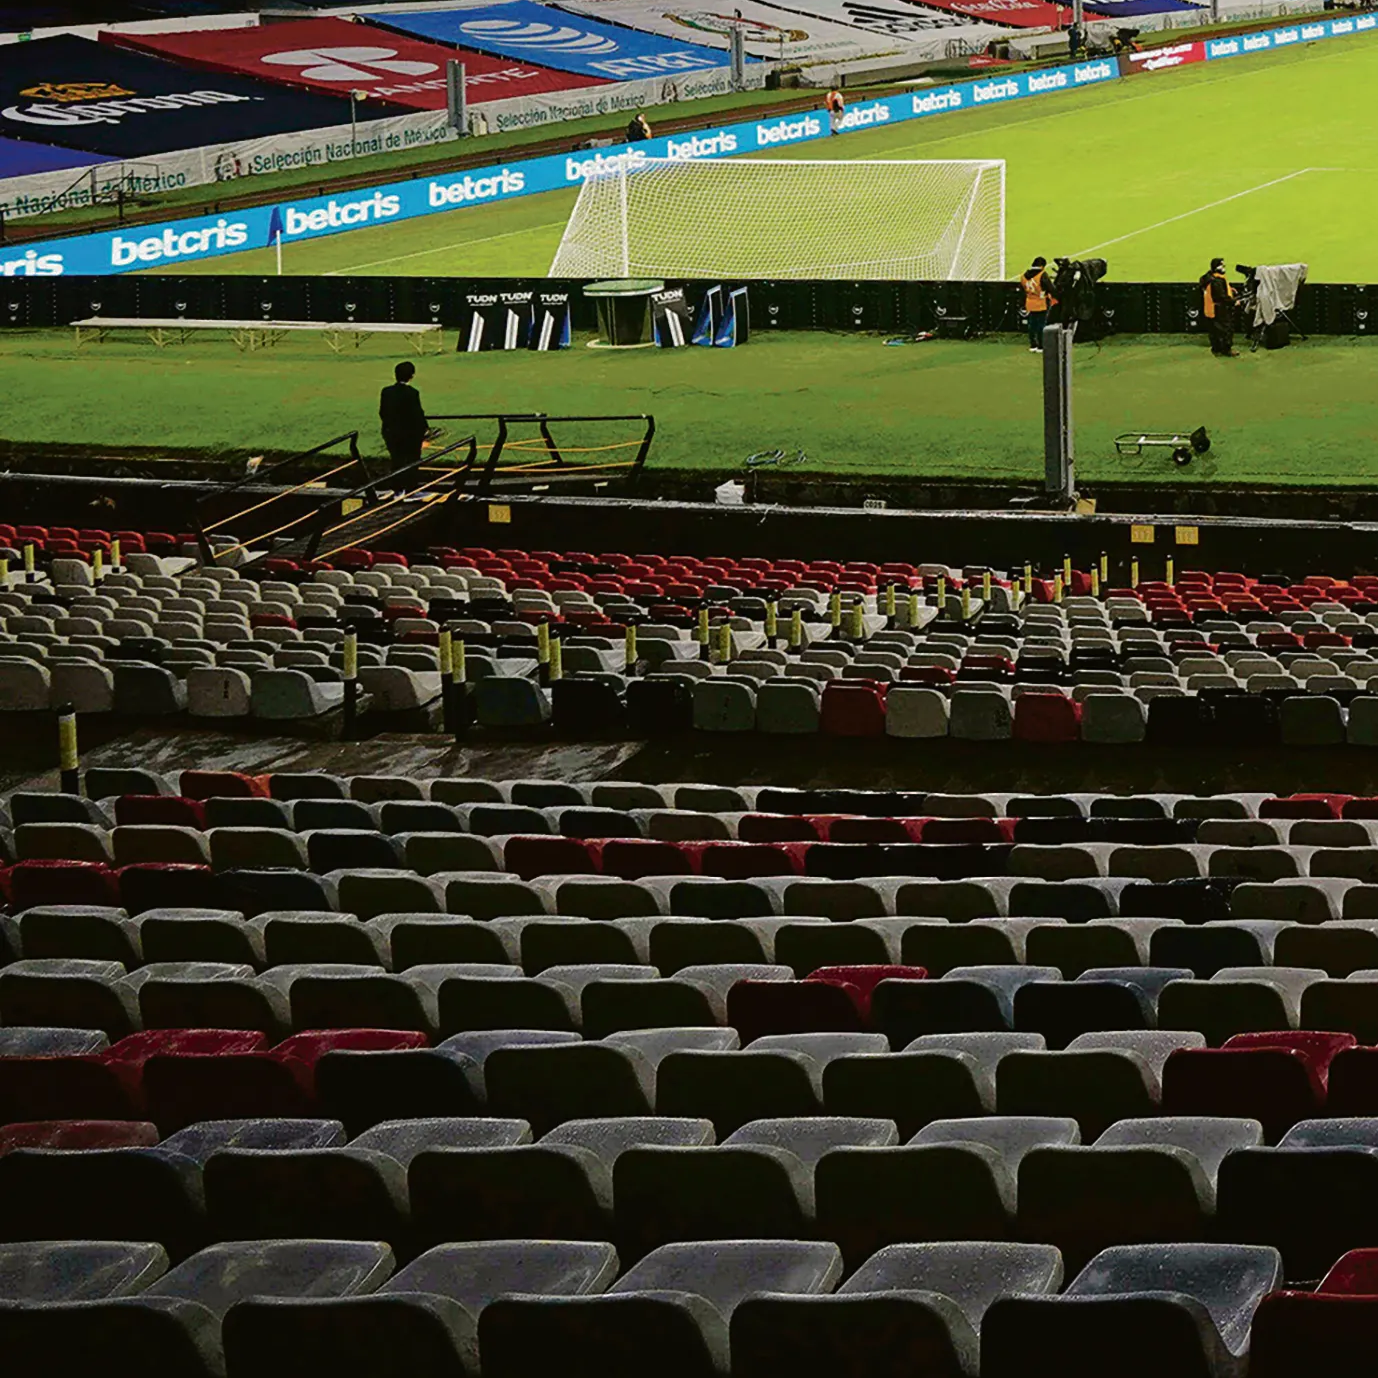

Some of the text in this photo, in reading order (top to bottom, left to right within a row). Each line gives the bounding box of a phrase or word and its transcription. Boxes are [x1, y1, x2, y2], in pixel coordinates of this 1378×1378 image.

[587, 50, 717, 76] AT&T
[496, 106, 547, 128] Selección
[597, 95, 608, 112] de
[253, 125, 447, 173] Selección Nacional de México
[0, 250, 64, 276] ris
[111, 219, 248, 266] betcris
[286, 191, 400, 235] betcris
[429, 168, 525, 208] betcris
[667, 130, 737, 159] betcris
[757, 115, 820, 143] betcris
[912, 88, 961, 113] betcris
[973, 78, 1018, 102] betcris
[466, 294, 498, 303] TUDN
[500, 291, 533, 302] TUDN
[540, 293, 569, 302] TUDN
[651, 289, 684, 303] TUDN
